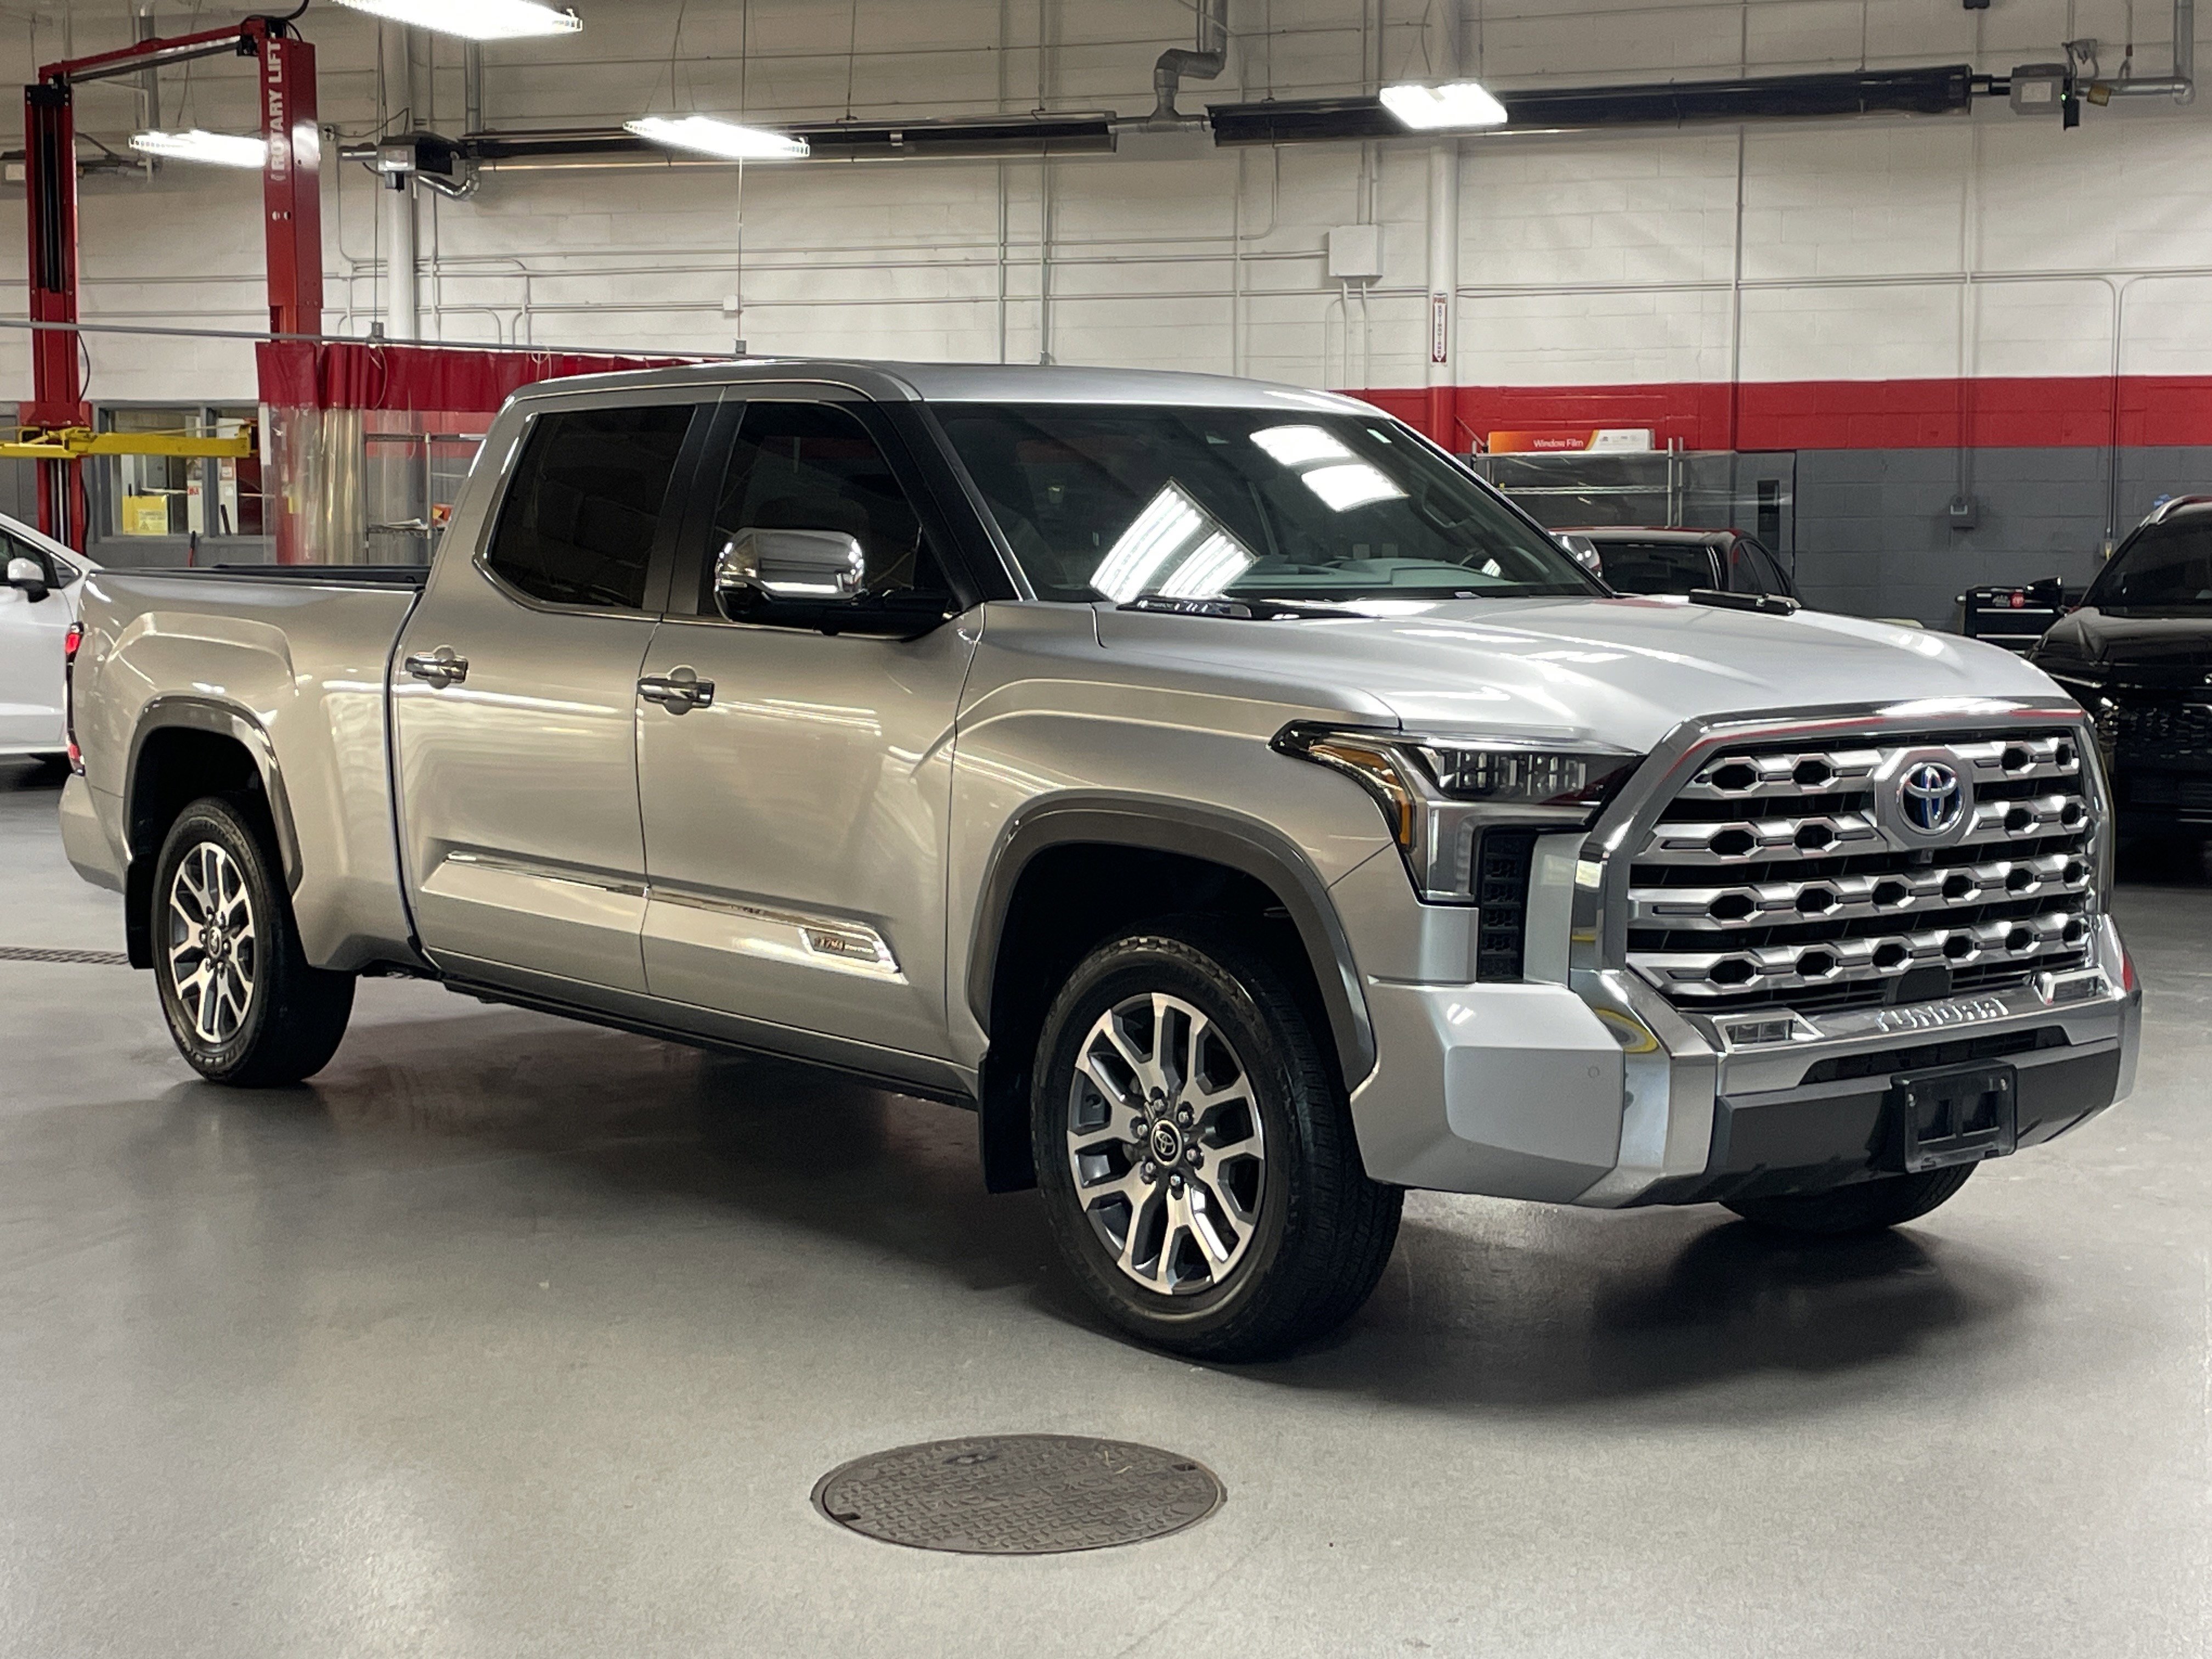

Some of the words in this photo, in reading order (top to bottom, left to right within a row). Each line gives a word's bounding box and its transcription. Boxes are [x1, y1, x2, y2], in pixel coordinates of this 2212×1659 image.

[267, 40, 283, 83] LIFT
[269, 88, 285, 171] ROTARY
[1533, 439, 1565, 448] Window
[1566, 439, 1584, 448] Film
